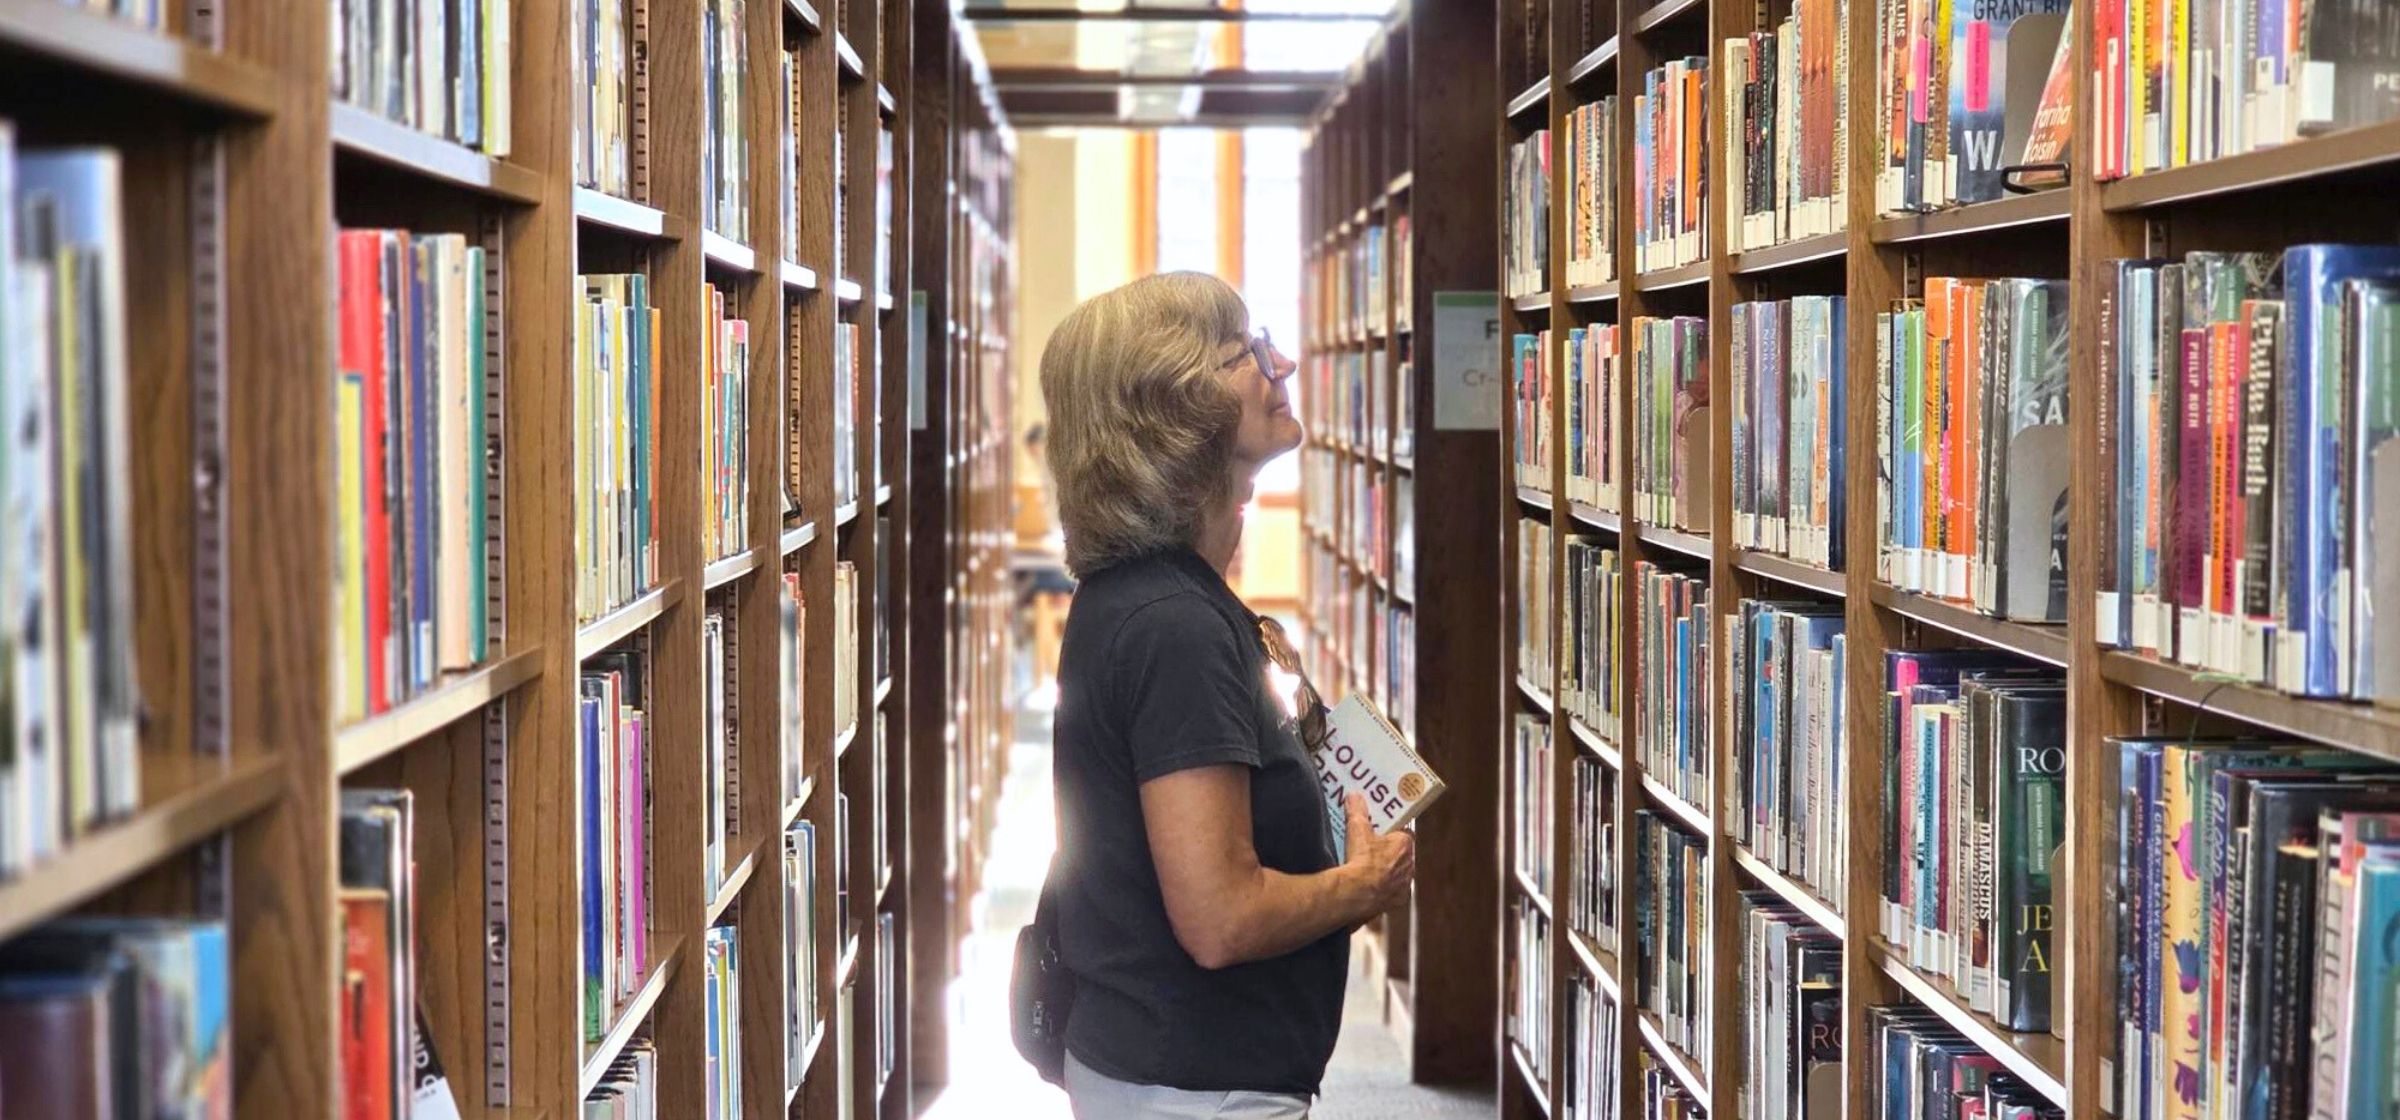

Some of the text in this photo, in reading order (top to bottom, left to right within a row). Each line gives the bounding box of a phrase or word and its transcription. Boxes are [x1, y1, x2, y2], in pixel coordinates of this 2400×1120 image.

[2099, 292, 2113, 337] The
[2188, 341, 2201, 388] PHILIP
[2217, 337, 2226, 382] PHILIP
[2228, 331, 2237, 382] PHILIP
[2099, 340, 2111, 456] Latecomers
[2188, 393, 2201, 428] ROTH
[2216, 388, 2225, 424] ROTH
[2227, 385, 2236, 422] ROTH
[2246, 315, 2275, 495] Philip Roth
[1323, 728, 1404, 820] LOUISE
[2154, 812, 2163, 865] CRAZY
[1979, 822, 1992, 921] DAMASCUS
[2020, 940, 2050, 973] A
[2210, 891, 2224, 982] SUGAR
[2271, 879, 2288, 1061] THE NEXT WIFE
[2285, 1008, 2297, 1065] HOME
